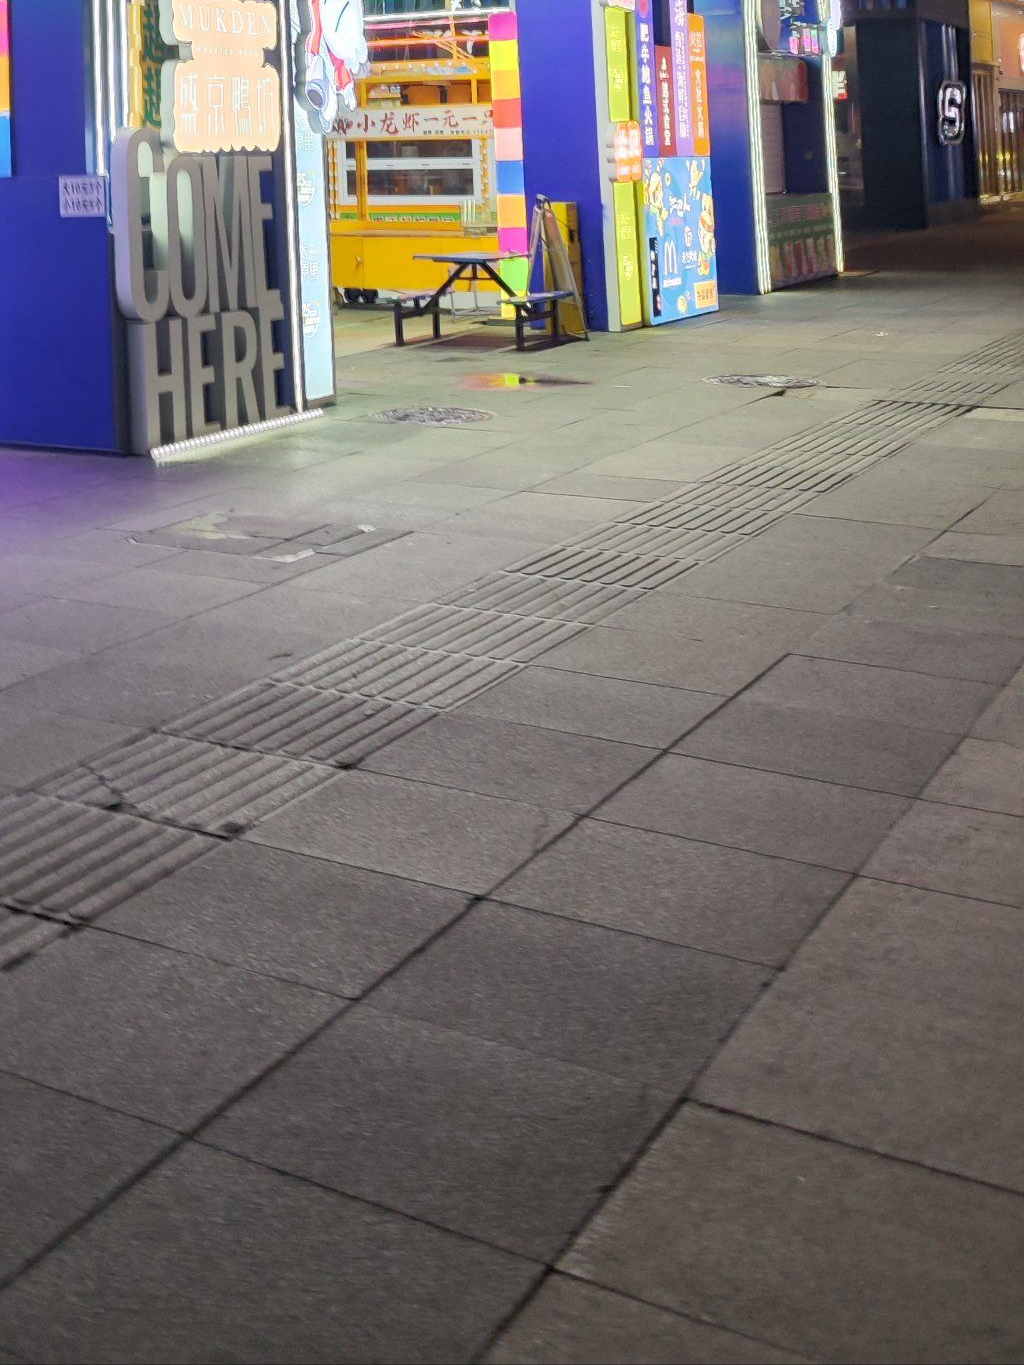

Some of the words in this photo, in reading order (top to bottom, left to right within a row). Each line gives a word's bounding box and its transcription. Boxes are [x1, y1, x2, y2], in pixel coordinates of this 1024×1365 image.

[178, 3, 273, 36] MUKDEN
[128, 127, 285, 324] COME
[145, 304, 286, 449] HERE
